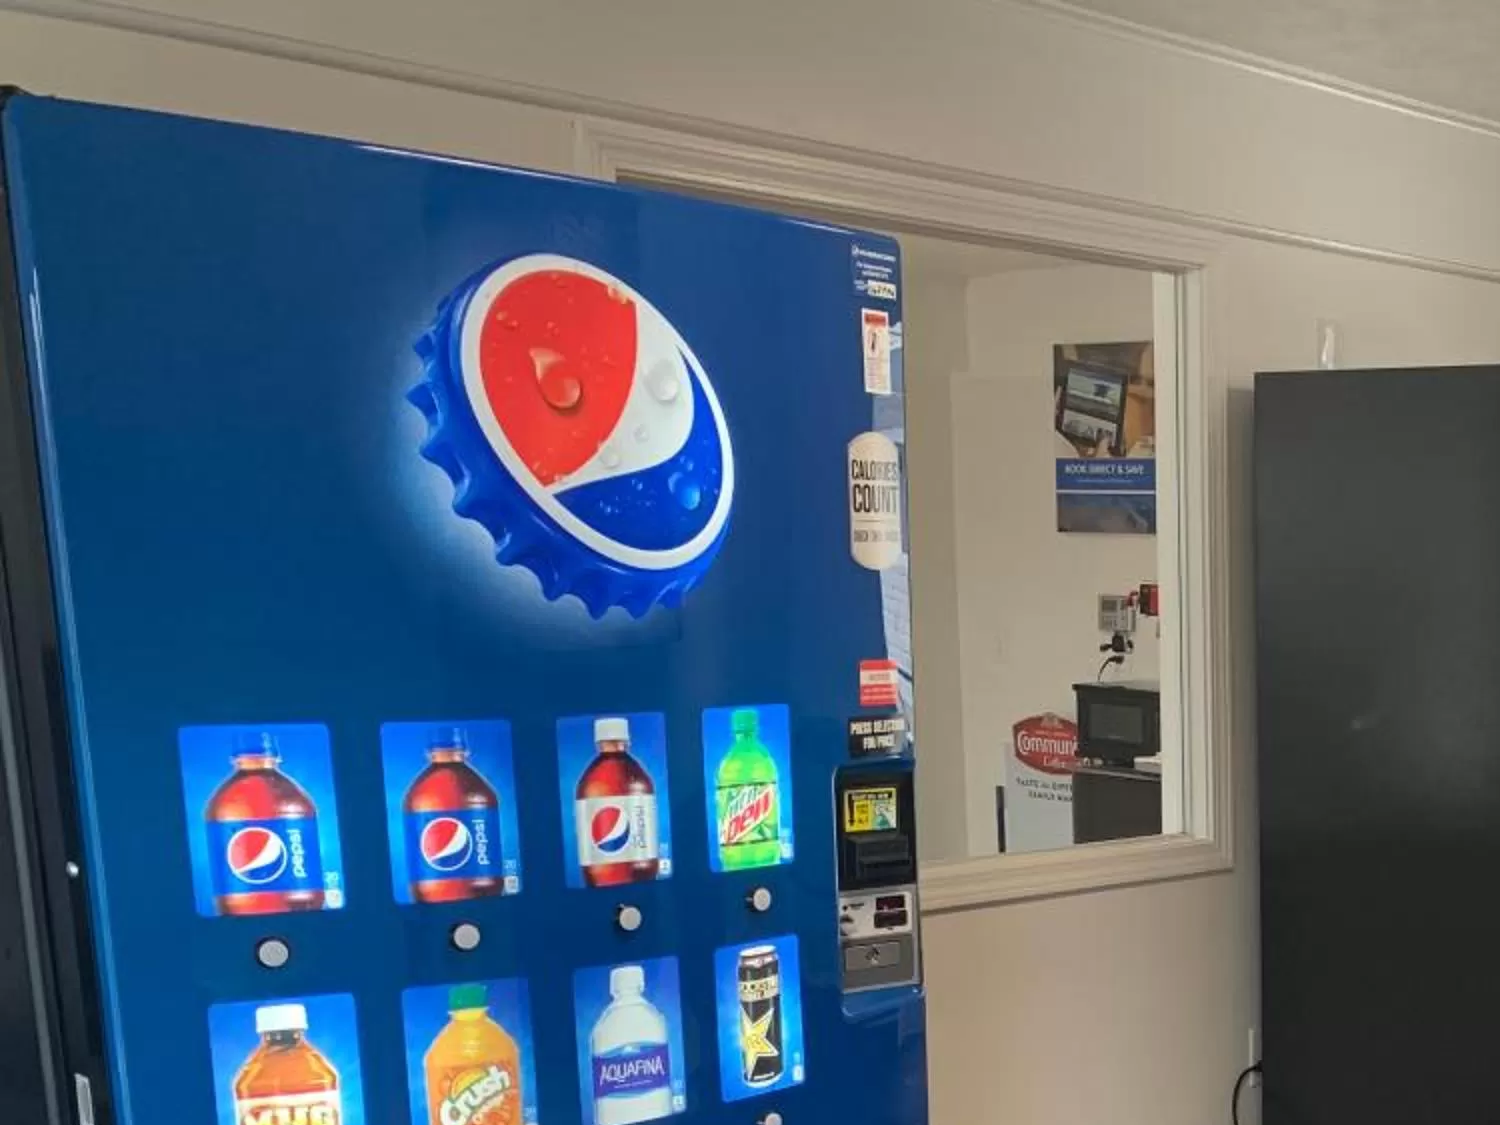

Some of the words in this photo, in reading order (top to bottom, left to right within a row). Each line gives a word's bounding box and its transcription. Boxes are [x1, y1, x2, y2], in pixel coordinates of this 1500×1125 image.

[851, 459, 897, 481] CALORIES
[853, 483, 899, 513] COUNT
[1017, 730, 1078, 756] Communi
[285, 829, 307, 878] pepsi
[471, 818, 491, 866] pepsi
[599, 1055, 666, 1087] AQUAFINA
